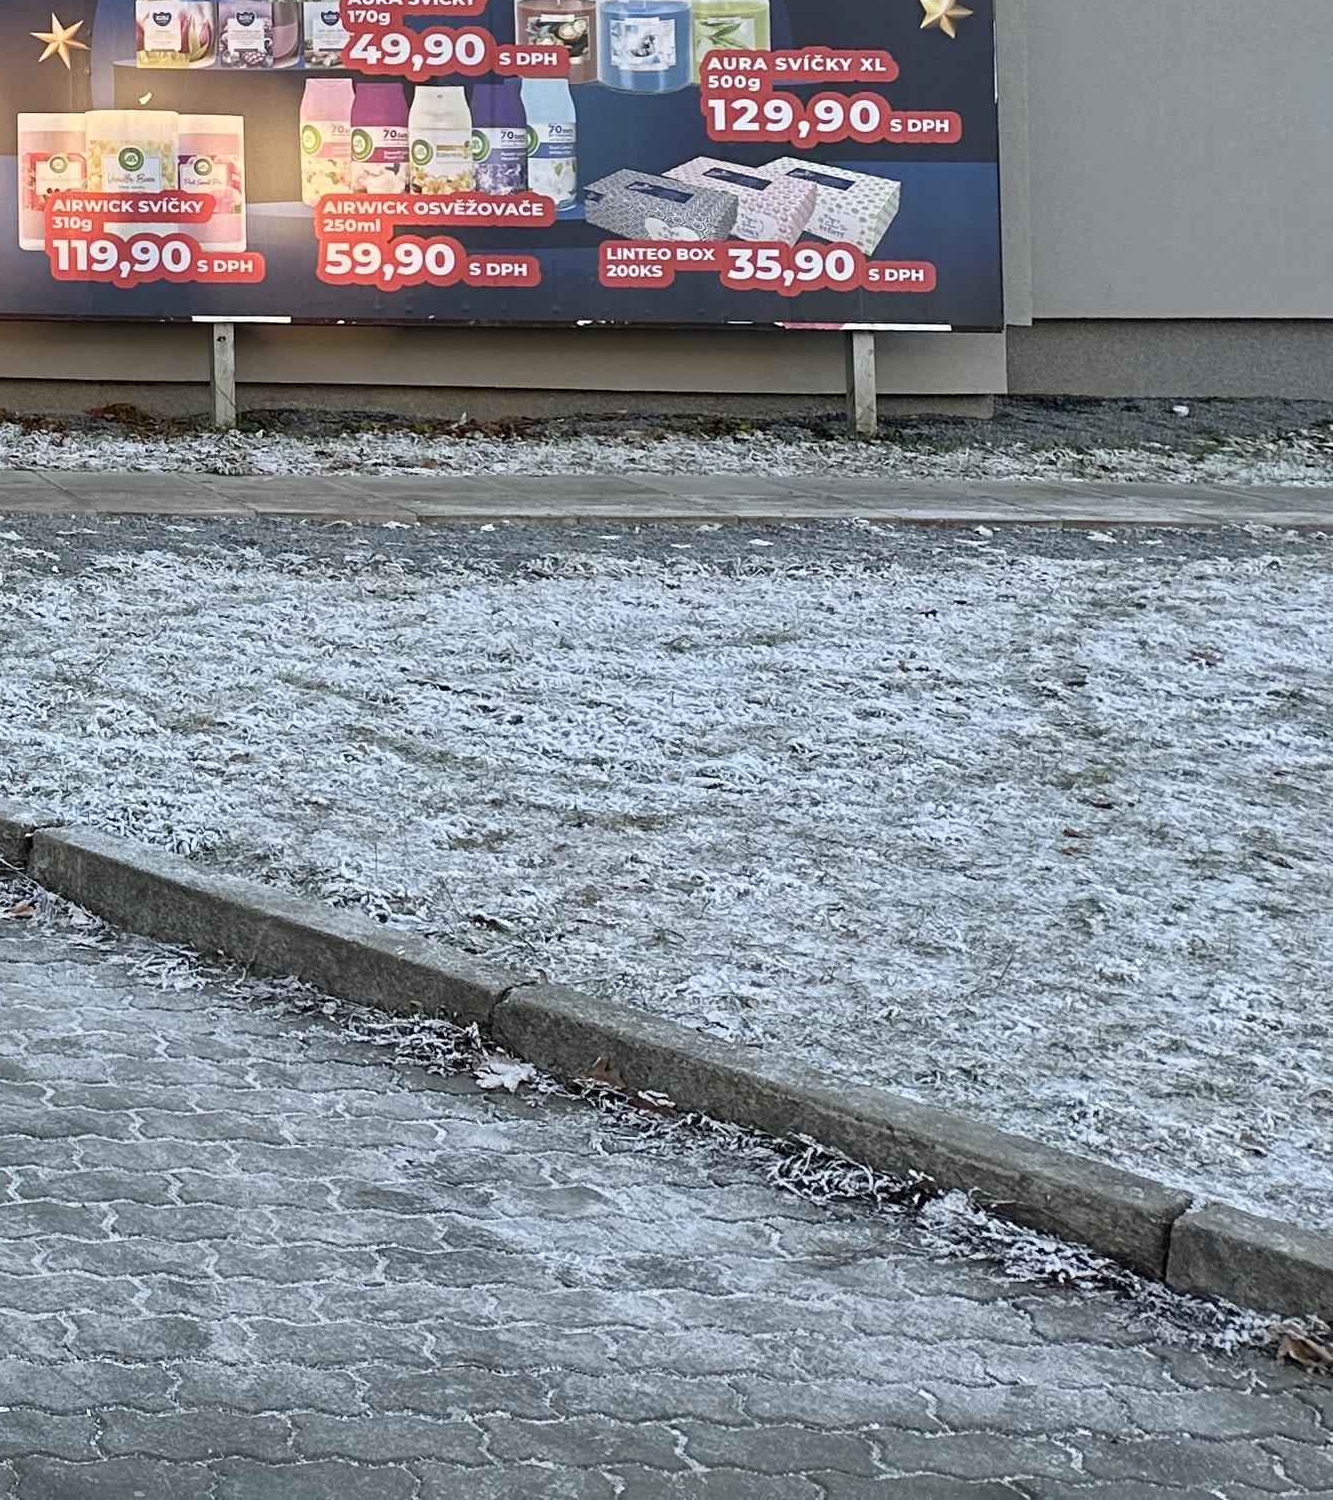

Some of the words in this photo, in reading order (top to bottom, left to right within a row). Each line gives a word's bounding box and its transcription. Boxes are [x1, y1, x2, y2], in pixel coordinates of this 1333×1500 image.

[347, 10, 391, 26] 170g
[349, 32, 486, 72] 49,90
[499, 52, 512, 66] S
[516, 52, 557, 66] DPH
[707, 57, 768, 71] AURA
[775, 54, 853, 71] SVÍČKY
[860, 58, 887, 71] XL
[707, 75, 761, 91] 500g
[707, 99, 881, 138] 129,90
[890, 119, 902, 132] S
[907, 119, 950, 132] DPH
[52, 199, 134, 213] AIRWICK
[138, 197, 204, 213] SVÍČKY
[322, 201, 410, 215] AIRWICK
[413, 198, 544, 216] OSVĚŽOVAČE
[52, 216, 93, 232] 310g
[322, 218, 381, 232] 250ml
[52, 239, 191, 278] 119,90
[197, 260, 209, 273] S
[213, 260, 253, 273] DPH
[324, 242, 456, 281] 59,90
[469, 263, 481, 277] S
[486, 263, 528, 277] DPH
[606, 248, 672, 261] LINTEO
[676, 248, 716, 261] BOX
[606, 264, 663, 277] 200KS
[727, 248, 855, 286] 35,90
[868, 269, 879, 282] S
[884, 269, 925, 282] DPH
